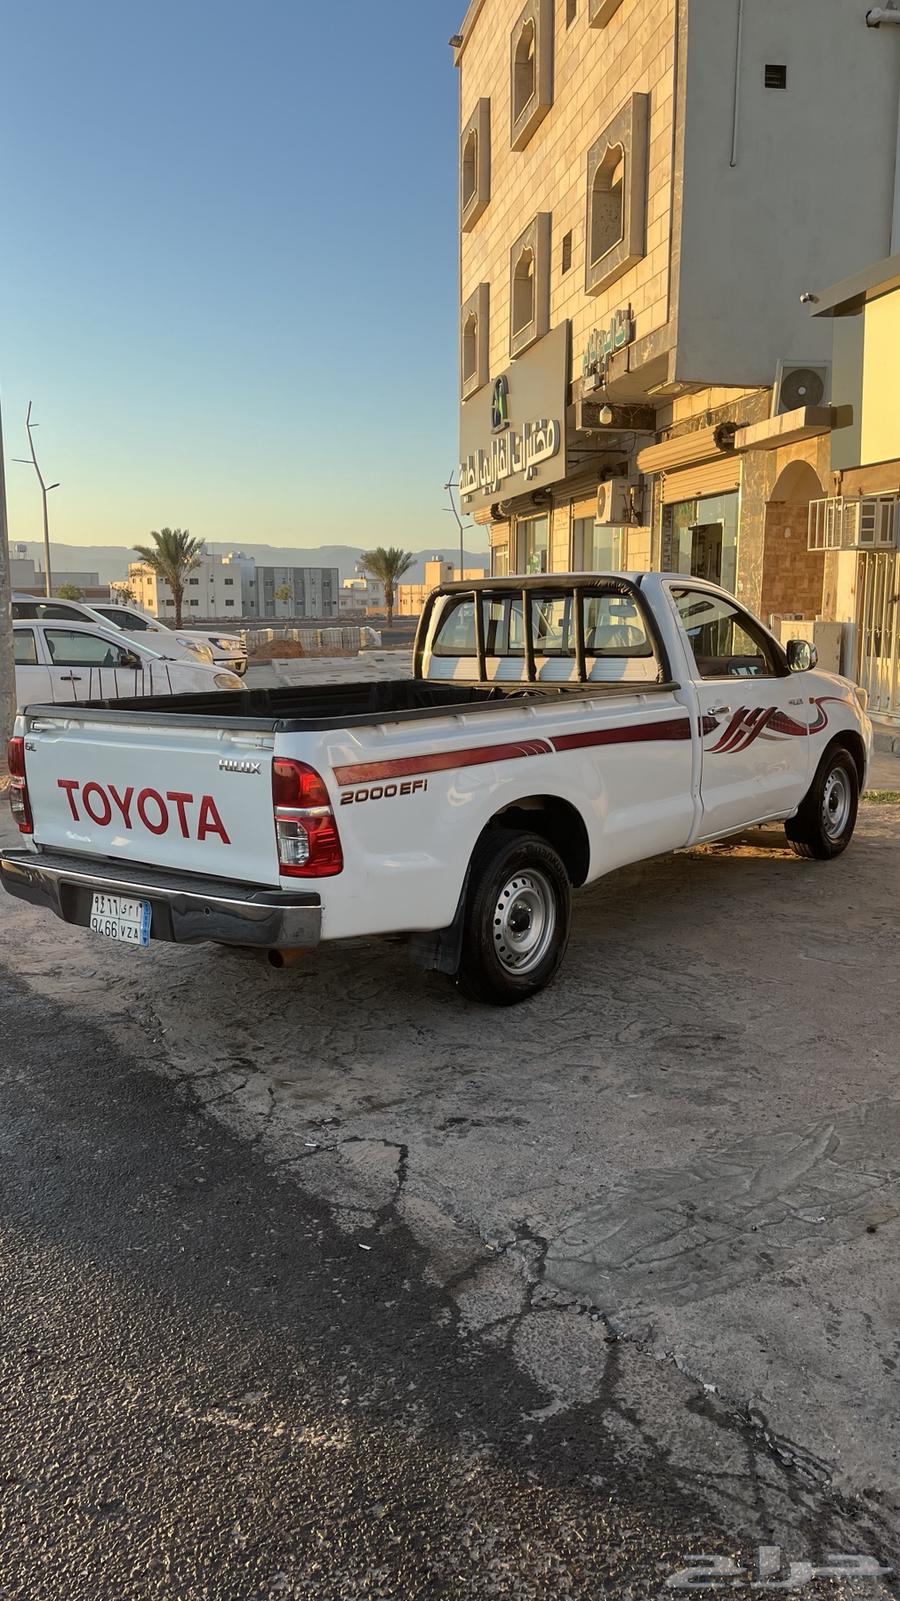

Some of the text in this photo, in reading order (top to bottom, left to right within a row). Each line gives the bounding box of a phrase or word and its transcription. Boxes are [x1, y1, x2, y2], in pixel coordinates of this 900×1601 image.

[218, 759, 262, 775] HILUX
[57, 779, 231, 844] TOYOTA
[91, 917, 139, 940] 9466 VZA
